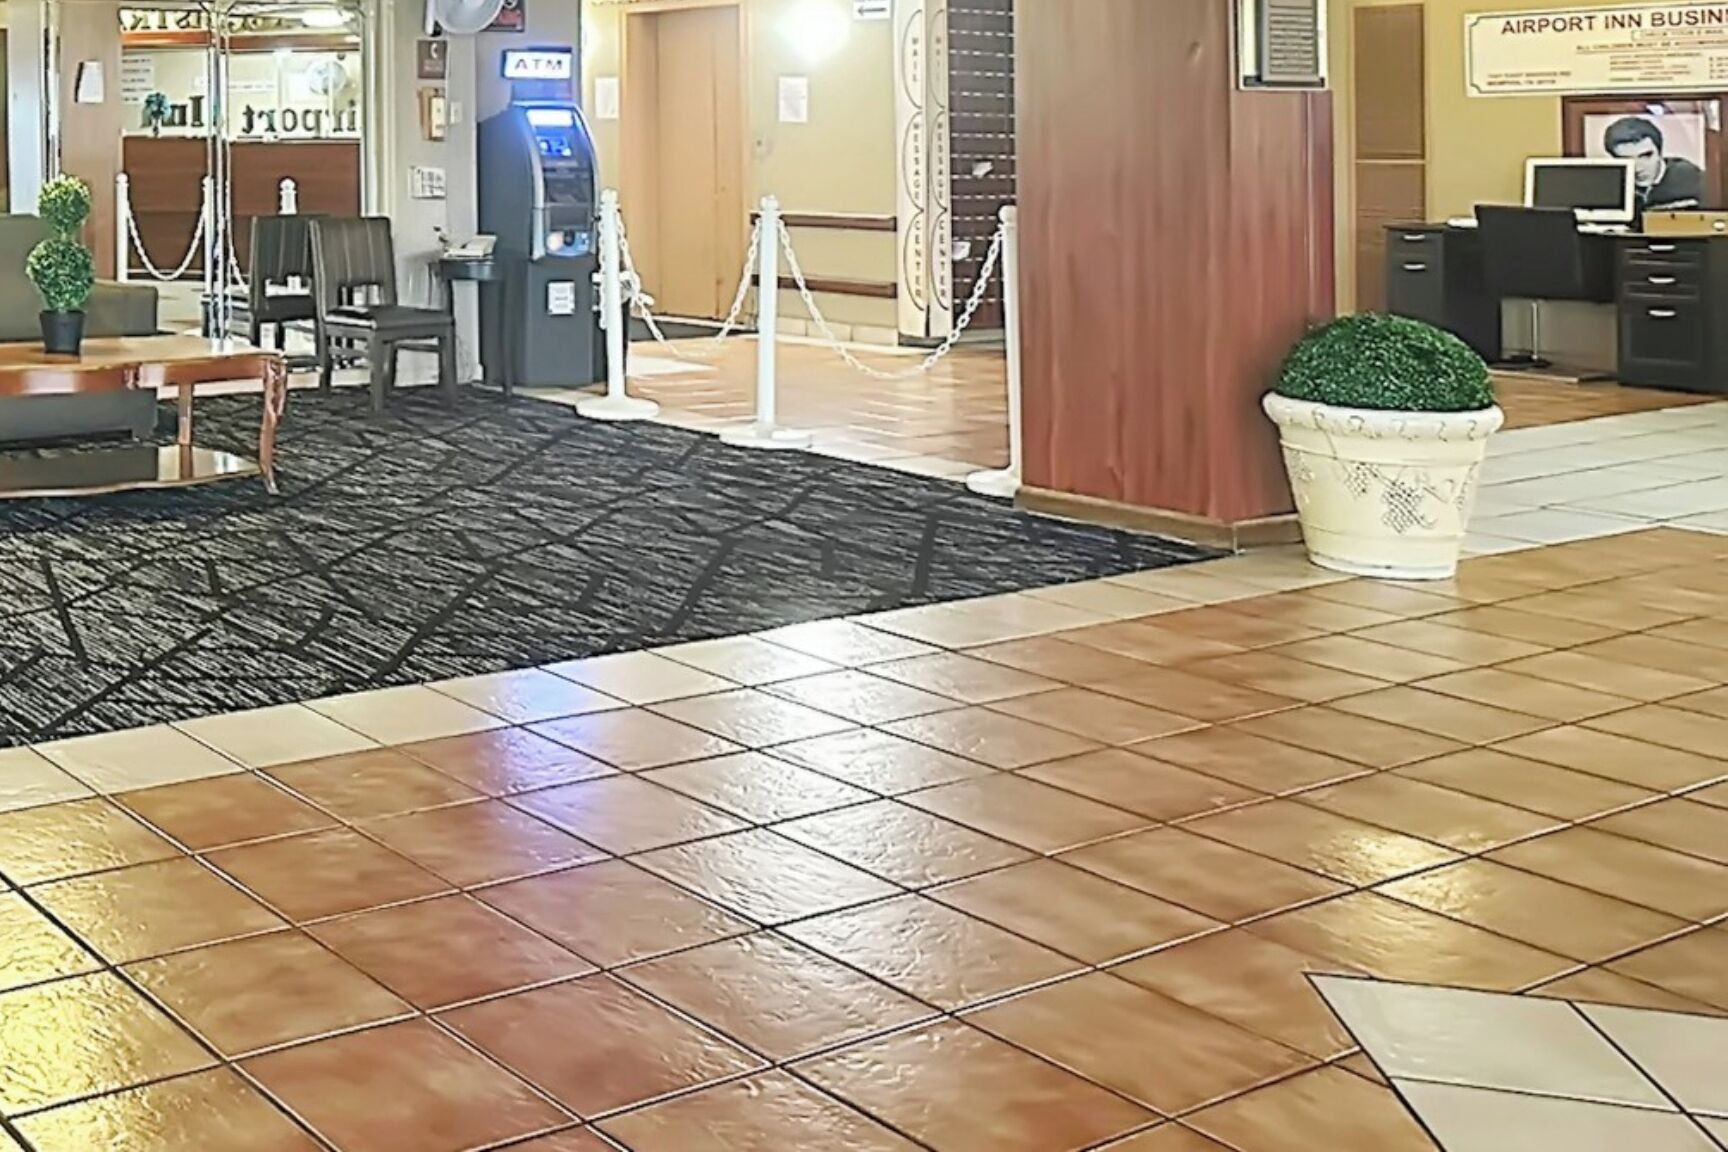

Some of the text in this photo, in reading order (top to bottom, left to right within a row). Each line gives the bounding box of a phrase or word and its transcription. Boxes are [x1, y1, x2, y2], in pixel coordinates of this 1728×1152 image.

[1501, 7, 1728, 35] AIRPORT INN BUSIN
[514, 58, 563, 70] ATM
[914, 219, 923, 298] CENTER
[938, 219, 947, 298] CENTER
